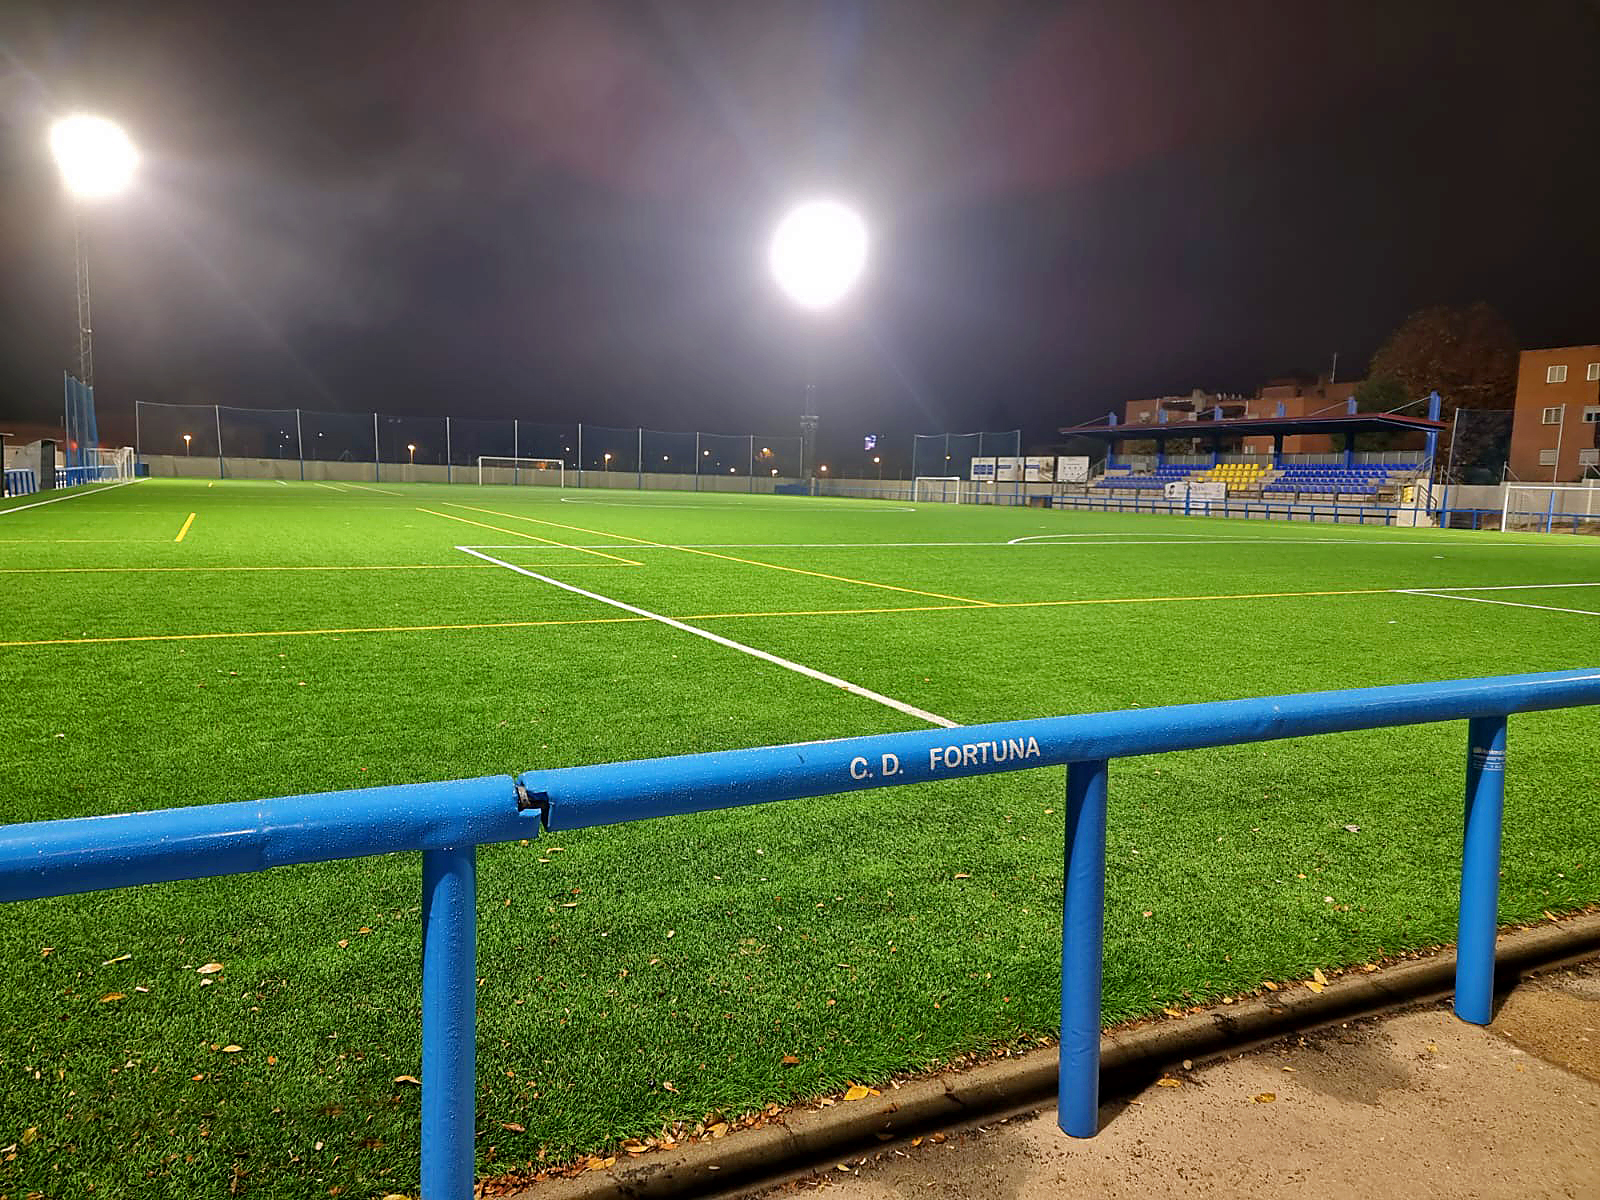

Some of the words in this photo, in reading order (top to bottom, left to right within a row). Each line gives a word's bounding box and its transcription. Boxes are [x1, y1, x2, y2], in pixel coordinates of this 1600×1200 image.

[850, 757, 873, 780] C.
[882, 753, 904, 776] D.
[929, 737, 1041, 770] FORTUNA
